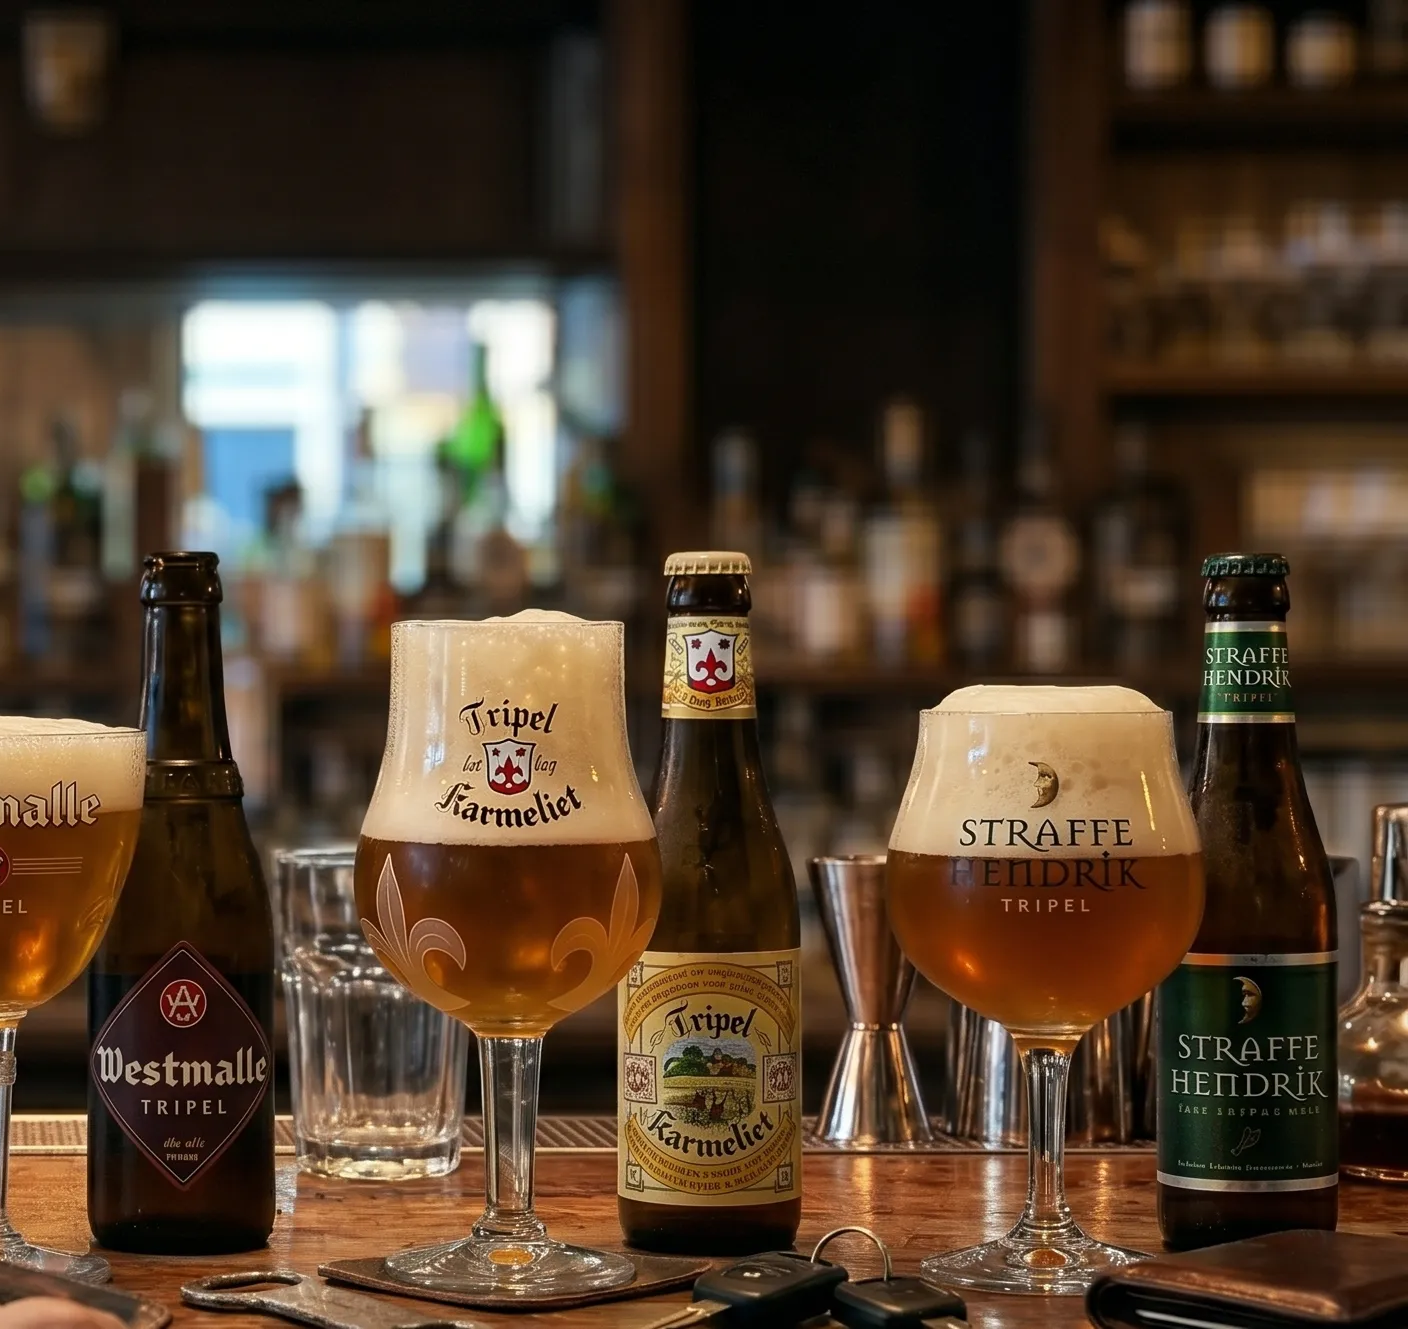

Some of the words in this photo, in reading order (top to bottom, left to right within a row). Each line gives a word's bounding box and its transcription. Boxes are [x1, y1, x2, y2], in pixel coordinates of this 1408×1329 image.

[1205, 647, 1289, 667] STRAFFE
[1203, 666, 1292, 689] HENDRIK
[459, 697, 559, 738] Tripel
[434, 782, 583, 829] Karmeliet
[959, 818, 1134, 852] STRAFFE
[949, 850, 1147, 892] HENDRIK
[1000, 898, 1091, 913] TRIPEL
[665, 1000, 758, 1040] Tripel
[97, 1045, 268, 1088] Westmalle
[1177, 1033, 1320, 1067] STRAFFE
[1170, 1066, 1329, 1102] HENDRIK
[141, 1099, 228, 1116] TRIPEL
[645, 1109, 774, 1158] Karmeliet
